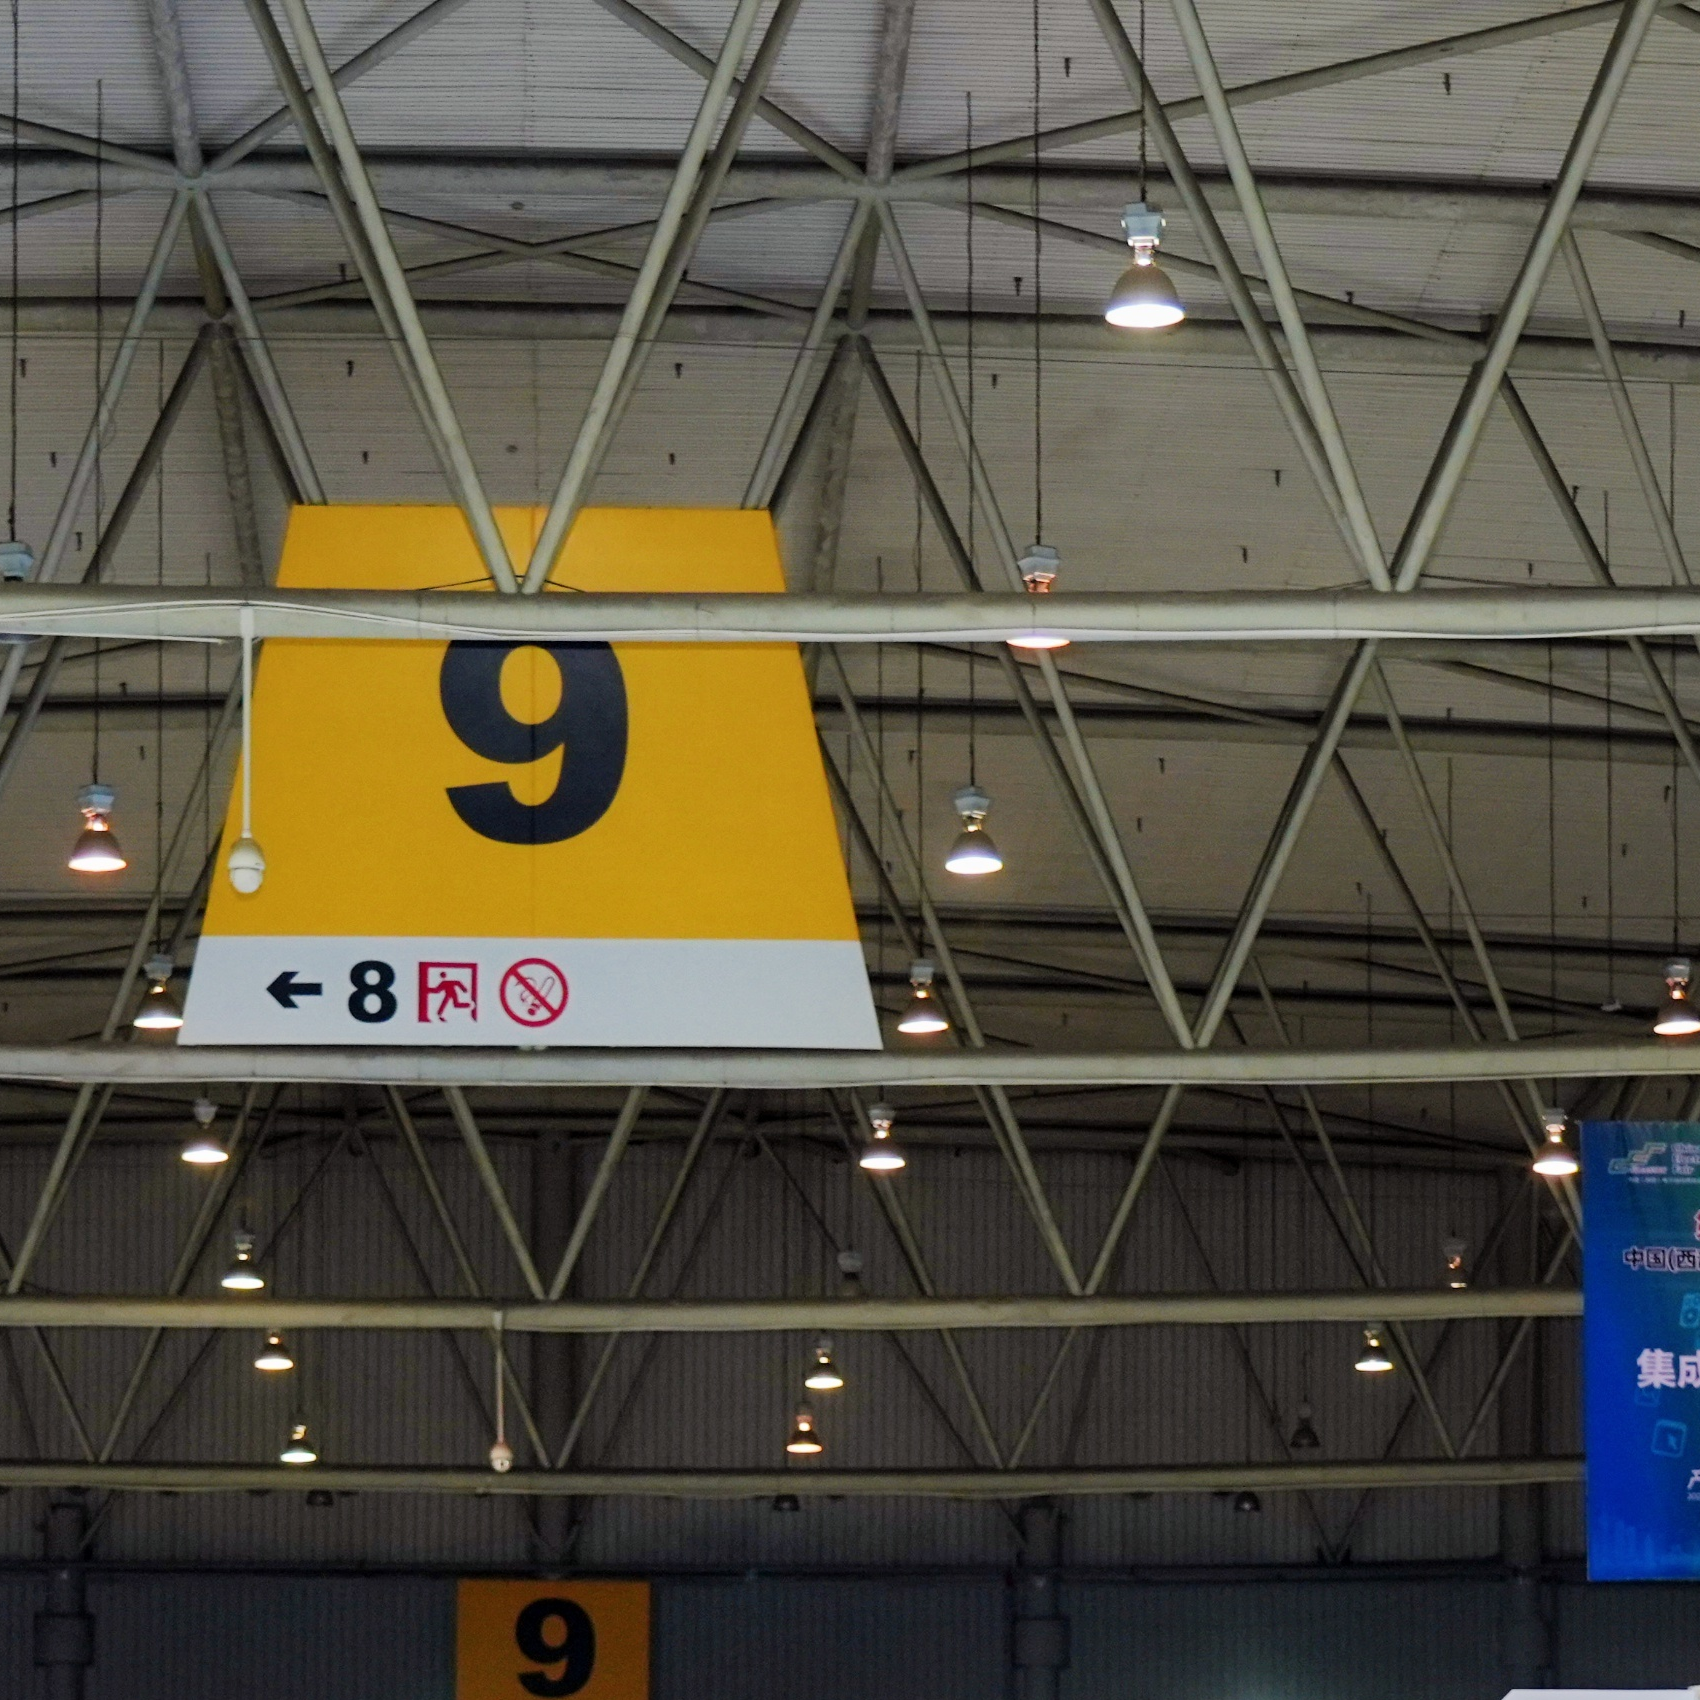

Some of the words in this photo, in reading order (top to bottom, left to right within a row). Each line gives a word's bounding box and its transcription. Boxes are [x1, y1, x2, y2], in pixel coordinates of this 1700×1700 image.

[439, 640, 628, 845] 9
[348, 960, 397, 1023] 8
[514, 1597, 597, 1698] 9
